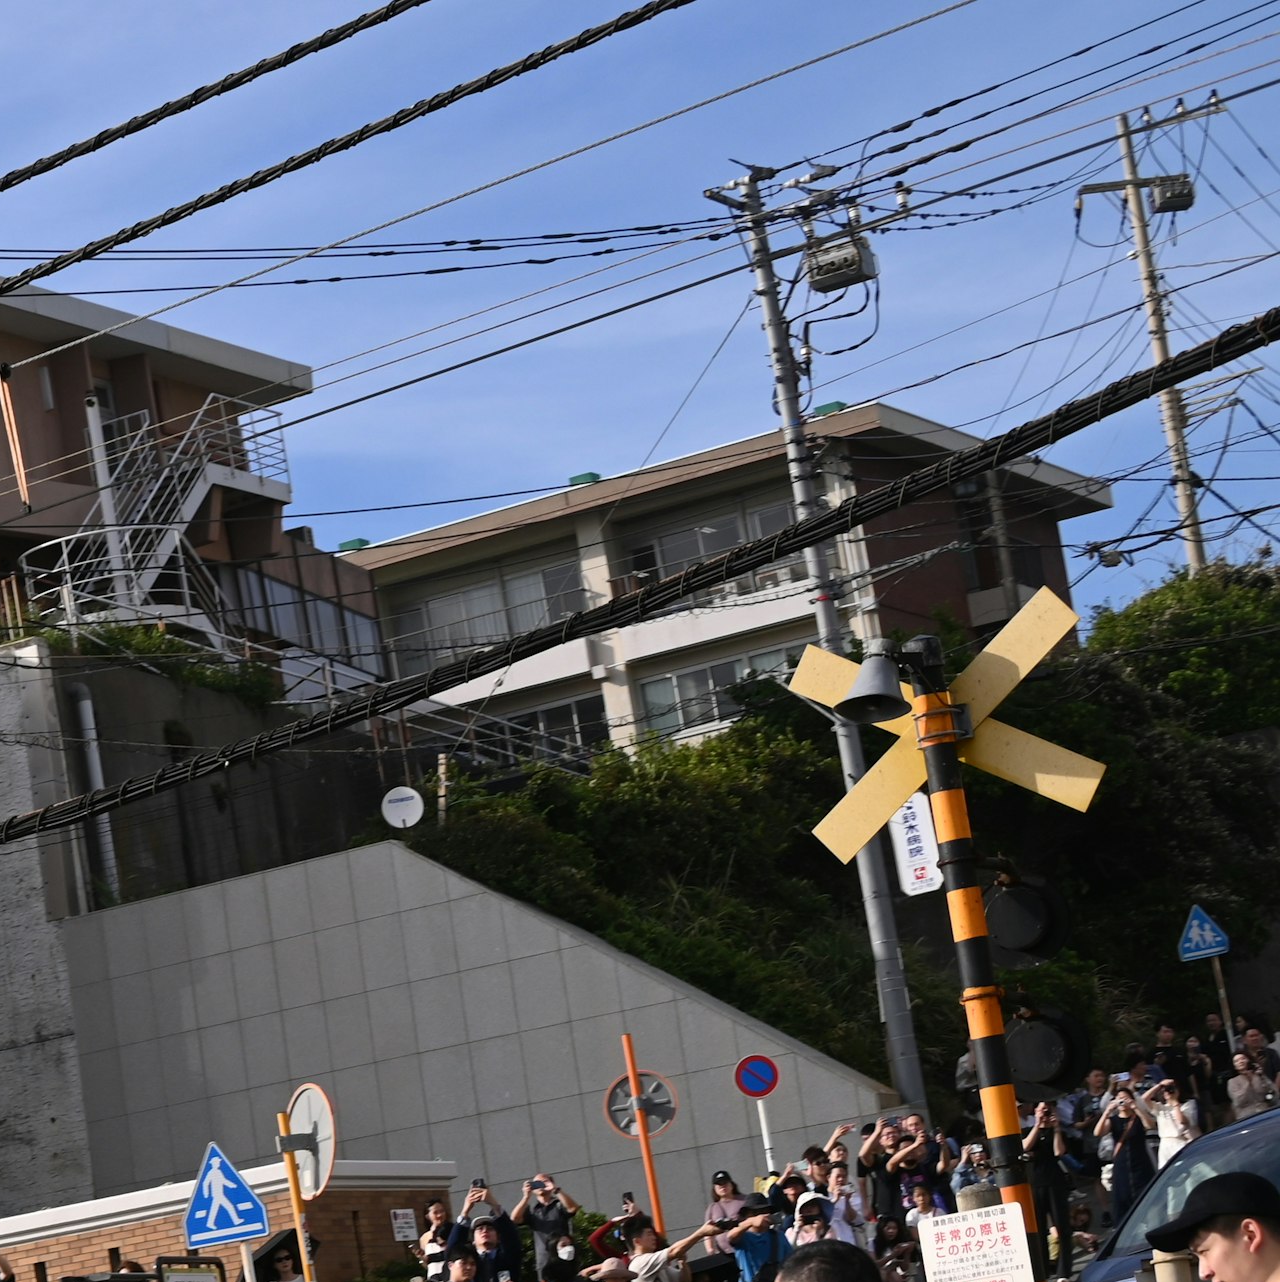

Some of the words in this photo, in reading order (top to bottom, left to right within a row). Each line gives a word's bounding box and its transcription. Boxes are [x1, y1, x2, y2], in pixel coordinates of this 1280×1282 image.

[934, 1221, 1007, 1245] 非常の際は
[936, 1235, 1012, 1258] このボタンを
